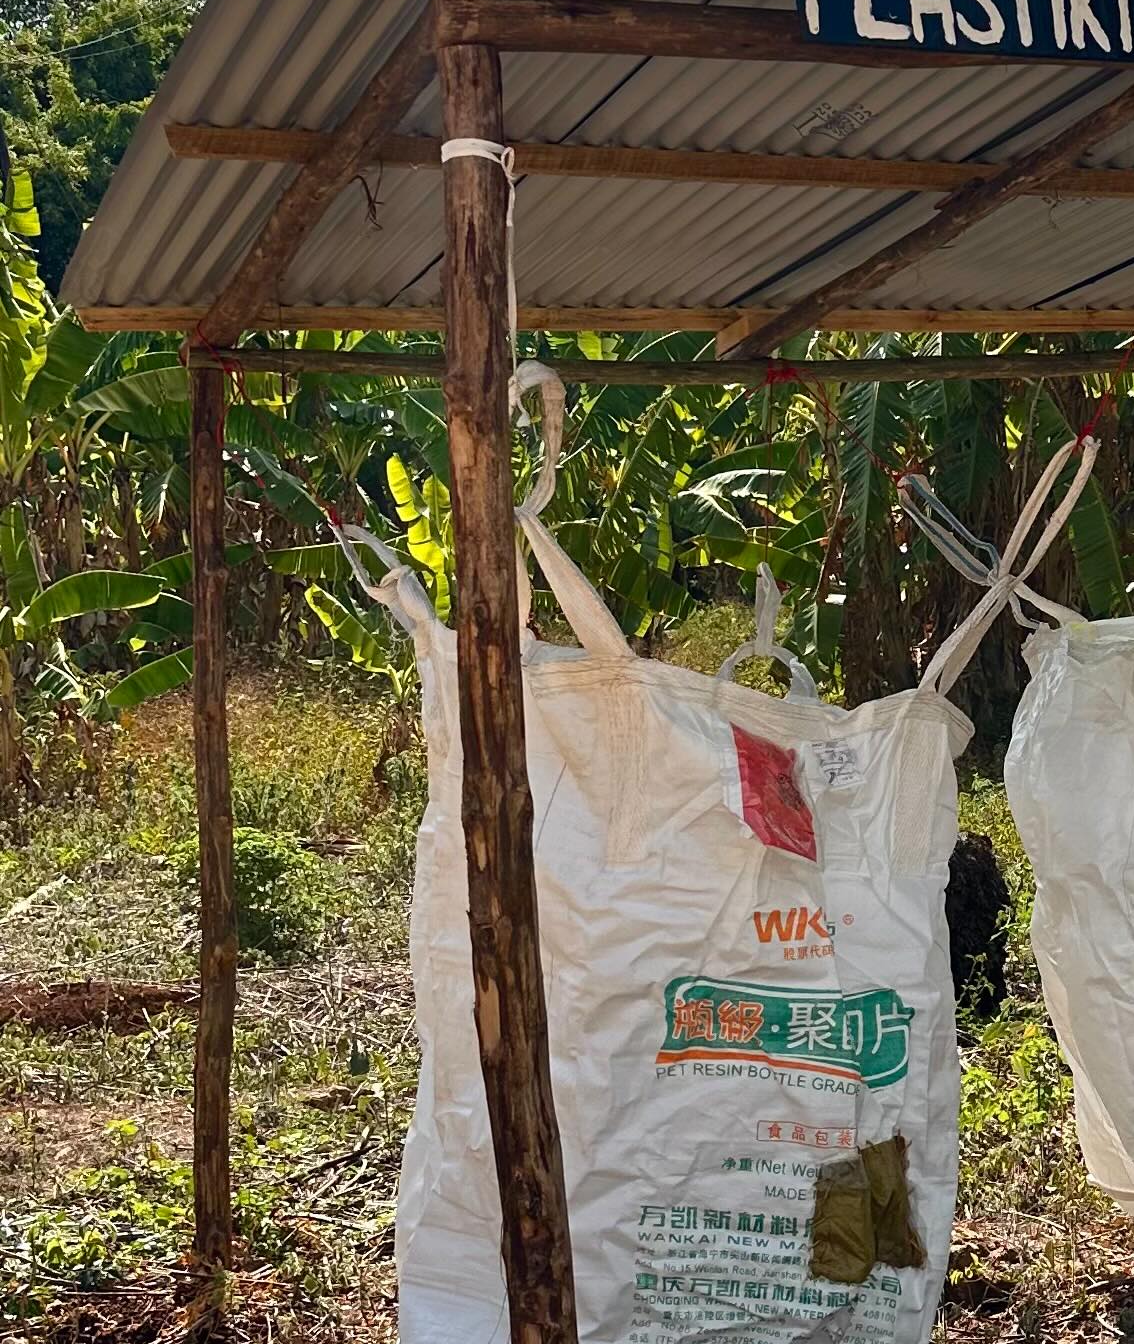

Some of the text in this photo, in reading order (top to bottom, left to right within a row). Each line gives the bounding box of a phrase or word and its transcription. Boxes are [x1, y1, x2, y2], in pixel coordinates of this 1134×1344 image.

[656, 1063, 686, 1080] PET
[693, 1063, 743, 1077] RESIN
[764, 1185, 807, 1201] MADE
[637, 1231, 717, 1245] WANKAI
[727, 1235, 770, 1249] NEW
